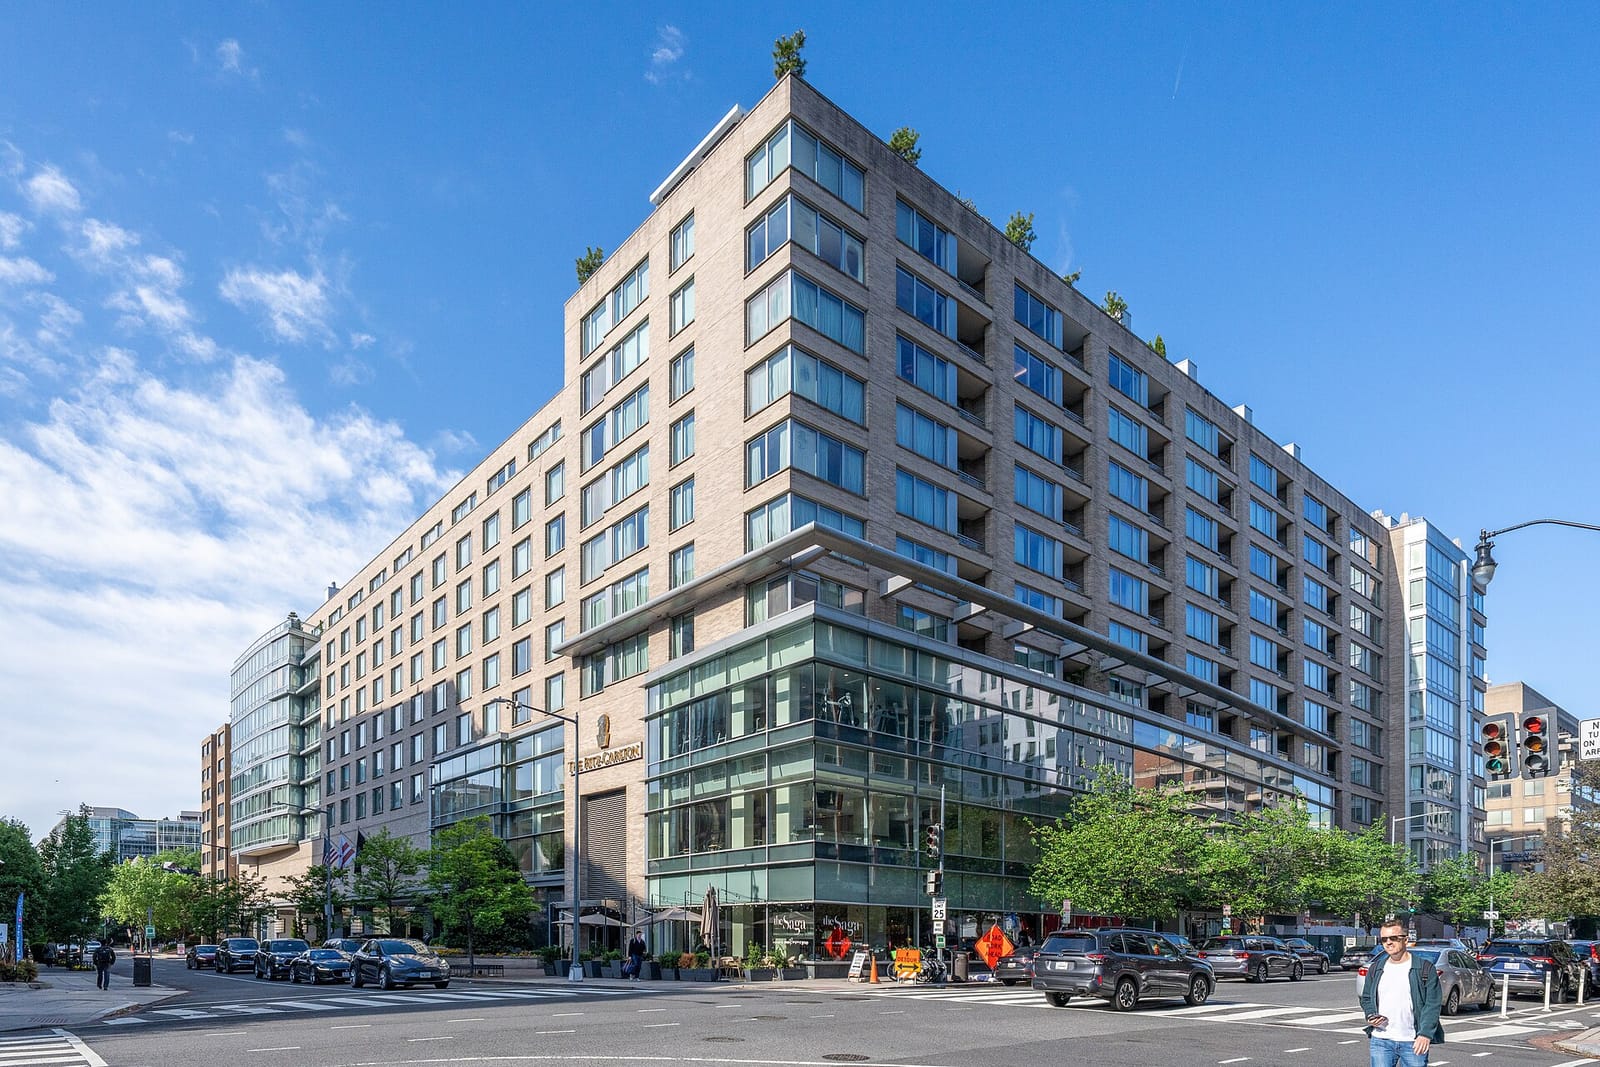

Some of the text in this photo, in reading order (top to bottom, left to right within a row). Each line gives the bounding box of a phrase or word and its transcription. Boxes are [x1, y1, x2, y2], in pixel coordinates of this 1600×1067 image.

[1592, 721, 1600, 730] N
[1588, 730, 1599, 738] TU
[1585, 748, 1600, 756] ARR
[568, 760, 583, 773] TE
[934, 909, 944, 919] 25
[773, 915, 806, 936] the Saga
[822, 915, 860, 937] the Saga
